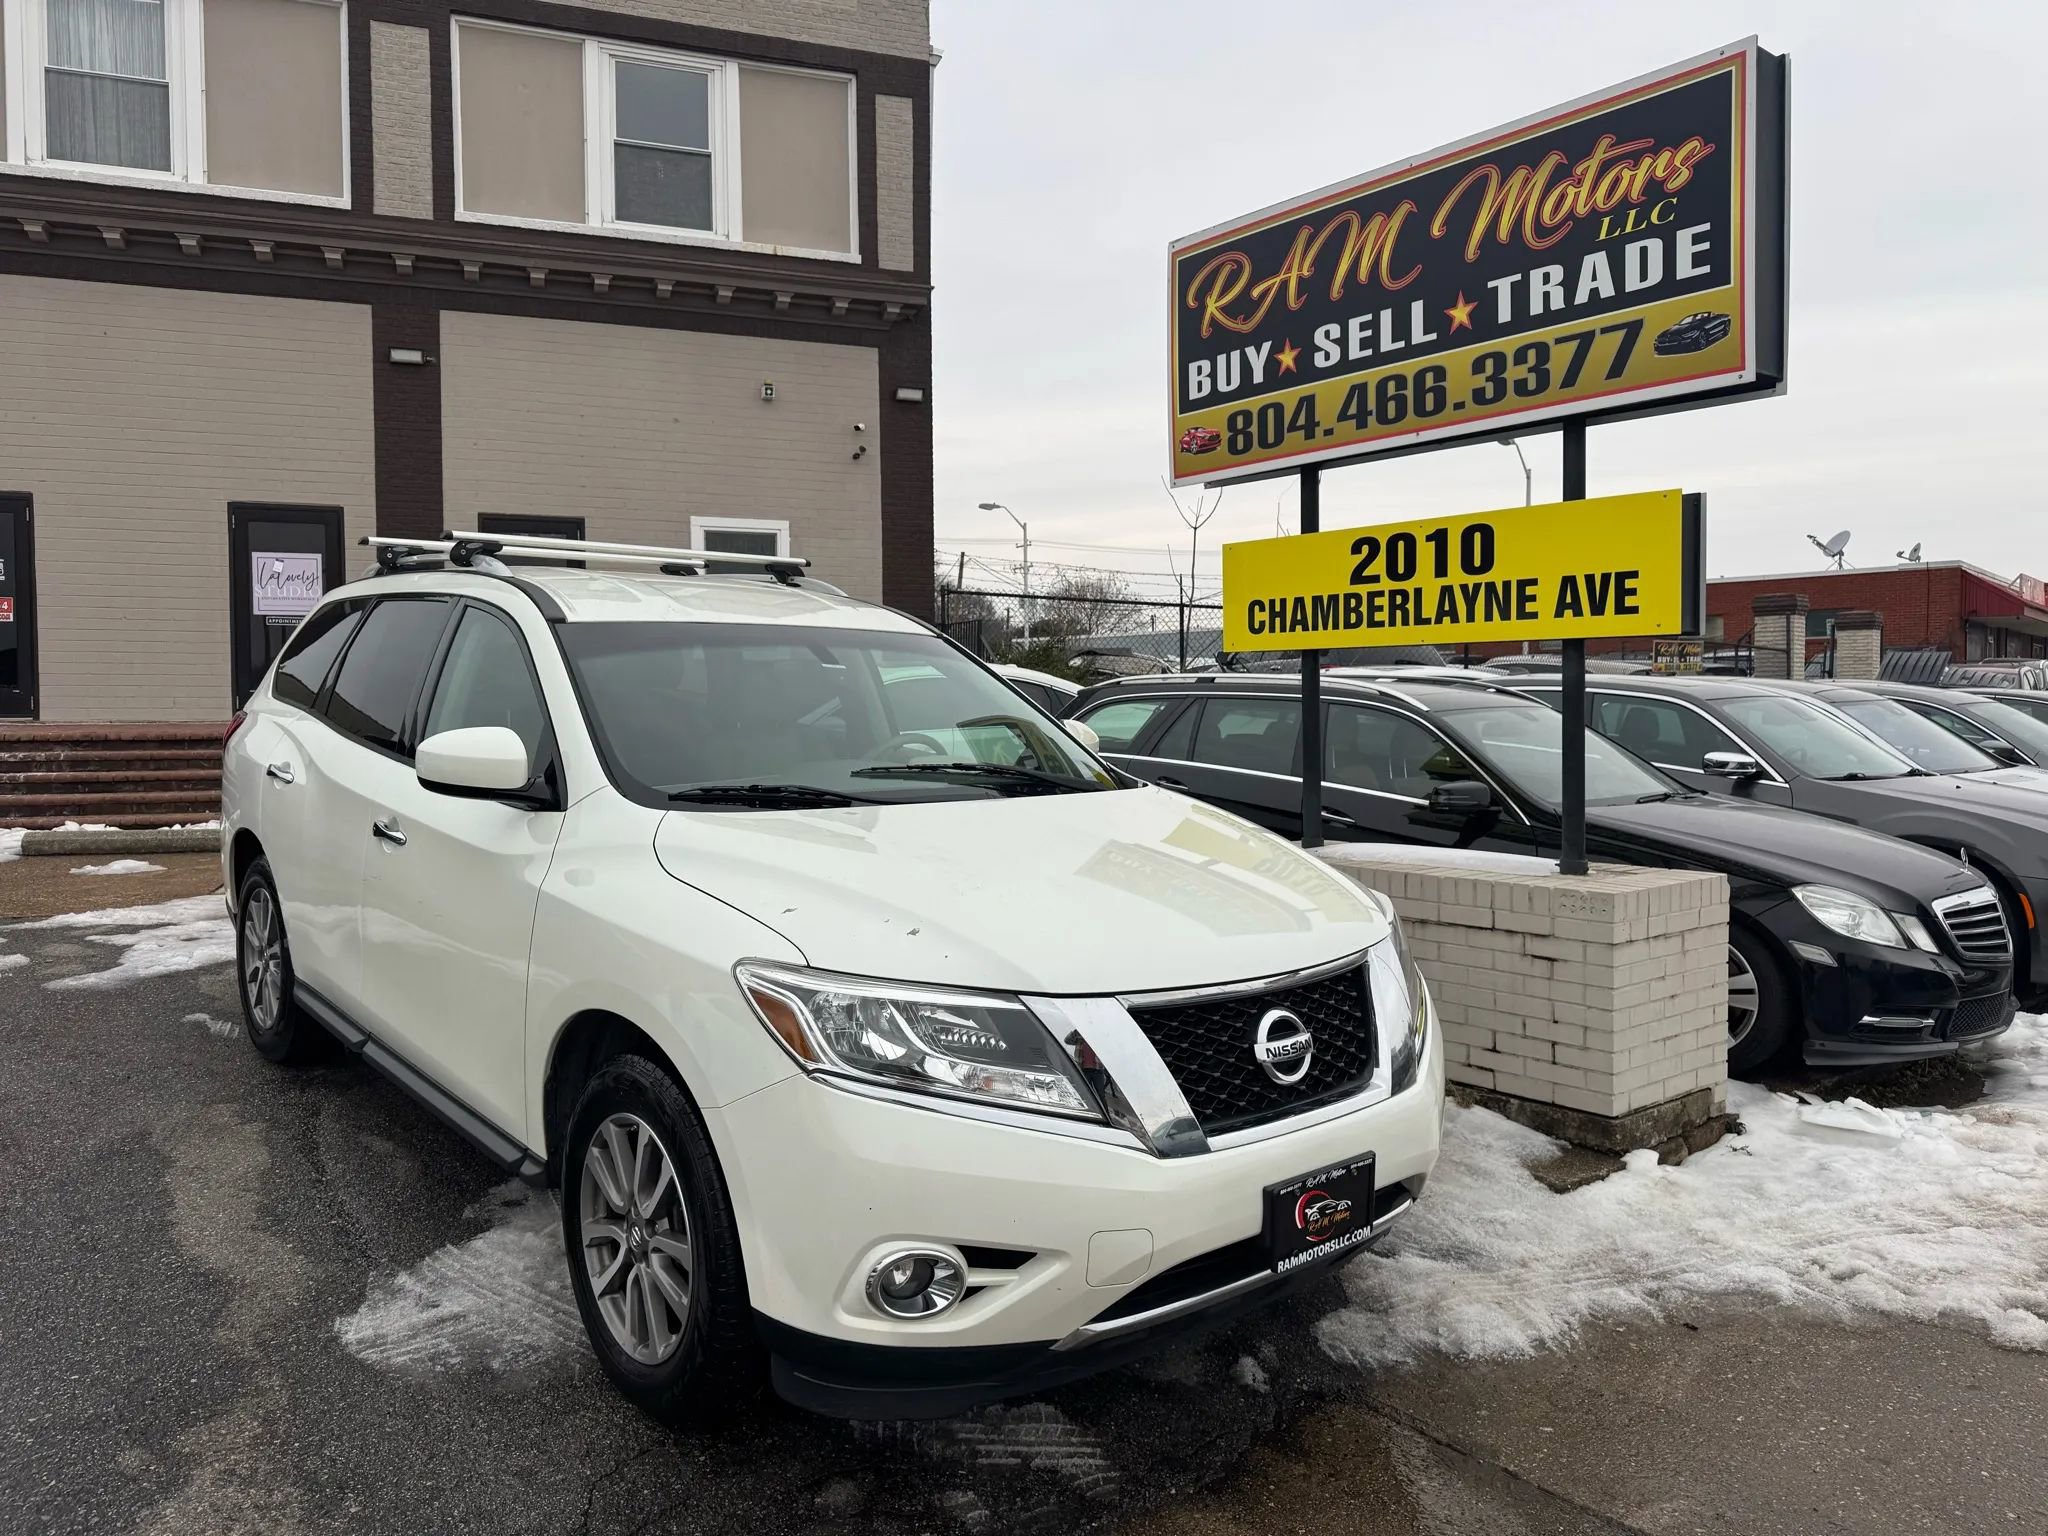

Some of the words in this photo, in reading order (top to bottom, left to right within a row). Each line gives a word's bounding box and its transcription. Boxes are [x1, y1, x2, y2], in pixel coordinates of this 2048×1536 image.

[1187, 200, 1423, 337] RAM
[1431, 133, 1715, 262] Motors
[1595, 196, 1679, 242] LLC
[1188, 339, 1274, 400] BUY
[1313, 299, 1438, 369] SELL
[1488, 221, 1712, 324] TRADE
[1226, 317, 1645, 457] 804.466.3377
[1349, 522, 1495, 586] 2010
[255, 584, 320, 598] STUDIO
[1247, 577, 1539, 636] CHAMBERLAYNE
[1553, 569, 1640, 619] AVE
[1265, 1038, 1312, 1059] NISSAN
[1277, 1225, 1371, 1273] RAMMOTORSLLC.COM
